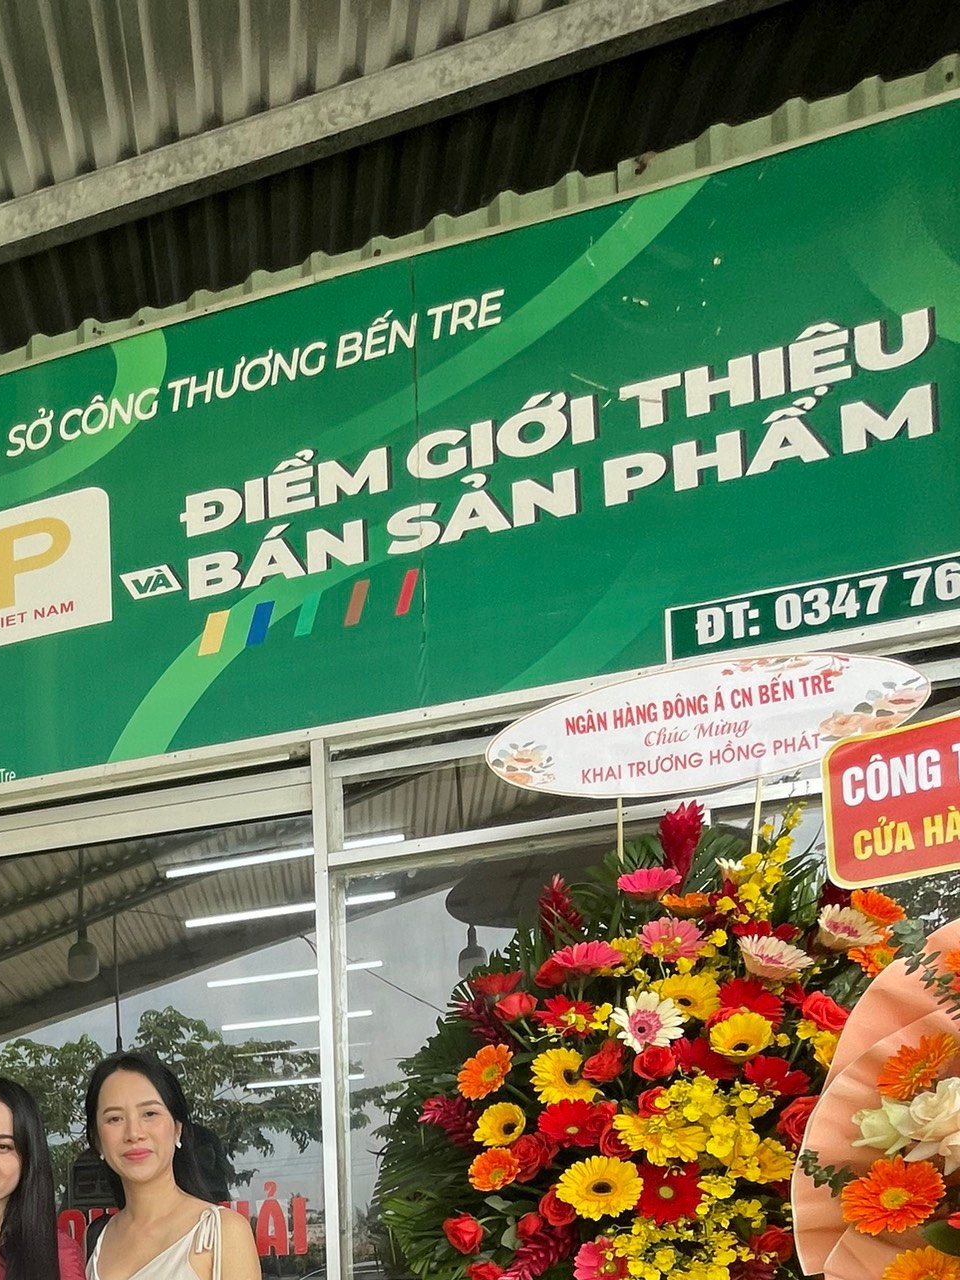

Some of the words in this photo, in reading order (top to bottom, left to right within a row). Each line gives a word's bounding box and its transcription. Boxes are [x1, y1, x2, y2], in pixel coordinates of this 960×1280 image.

[5, 408, 53, 457] SỞ
[59, 387, 161, 439] CÔNG
[167, 341, 327, 412] THƯƠNG
[336, 309, 418, 368] BẾN
[427, 288, 505, 340] TRE
[180, 446, 390, 538] ĐIỂM
[406, 390, 596, 479] GIỚI
[619, 307, 933, 428] THIỆU
[128, 567, 176, 595] VÀ
[188, 519, 367, 600] BÁN
[387, 468, 580, 554] SẢN
[603, 383, 935, 507] PHẨM
[33, 600, 74, 619] NAM
[695, 602, 760, 646] ĐT:
[774, 575, 888, 631] 0347
[903, 562, 960, 607] 76
[565, 707, 608, 736] NGÂN
[612, 702, 658, 730] HÀNG
[663, 692, 709, 721] ĐÔNG
[714, 686, 725, 712] Á
[731, 685, 754, 708] CN
[760, 673, 795, 705] BẾN
[799, 674, 835, 698] TRE
[644, 726, 692, 748] Chúc
[695, 716, 753, 740] Mừng
[581, 765, 622, 784] KHAI
[628, 749, 703, 776] TRƯƠNG
[709, 736, 767, 764] HỒNG
[773, 729, 822, 756] PHÁT
[842, 748, 942, 807] CÔNG
[853, 816, 916, 861] CỬA
[218, 1181, 307, 1256] ẢI
